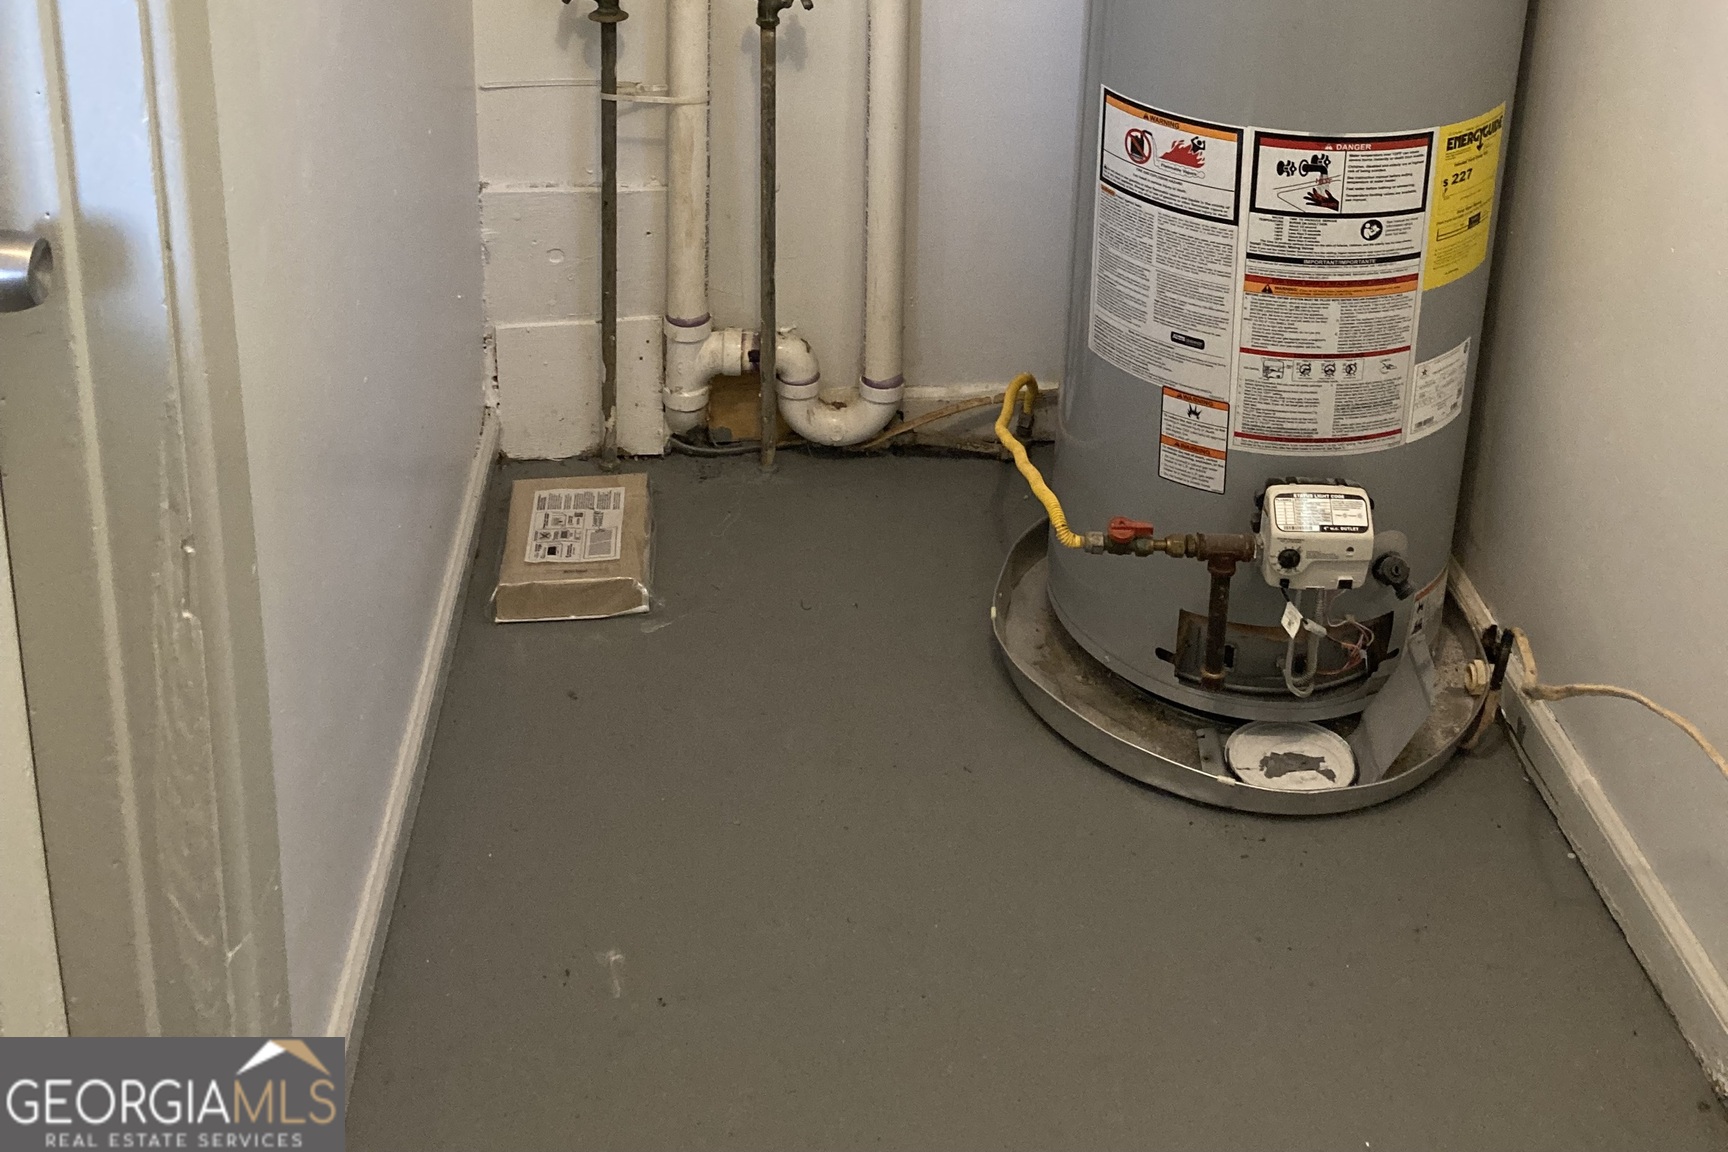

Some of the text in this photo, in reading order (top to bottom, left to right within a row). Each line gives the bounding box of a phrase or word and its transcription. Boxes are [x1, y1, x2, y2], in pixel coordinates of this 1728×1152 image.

[1149, 115, 1180, 130] WARNING
[1336, 143, 1371, 151] DANGER
[1451, 168, 1473, 185] 227
